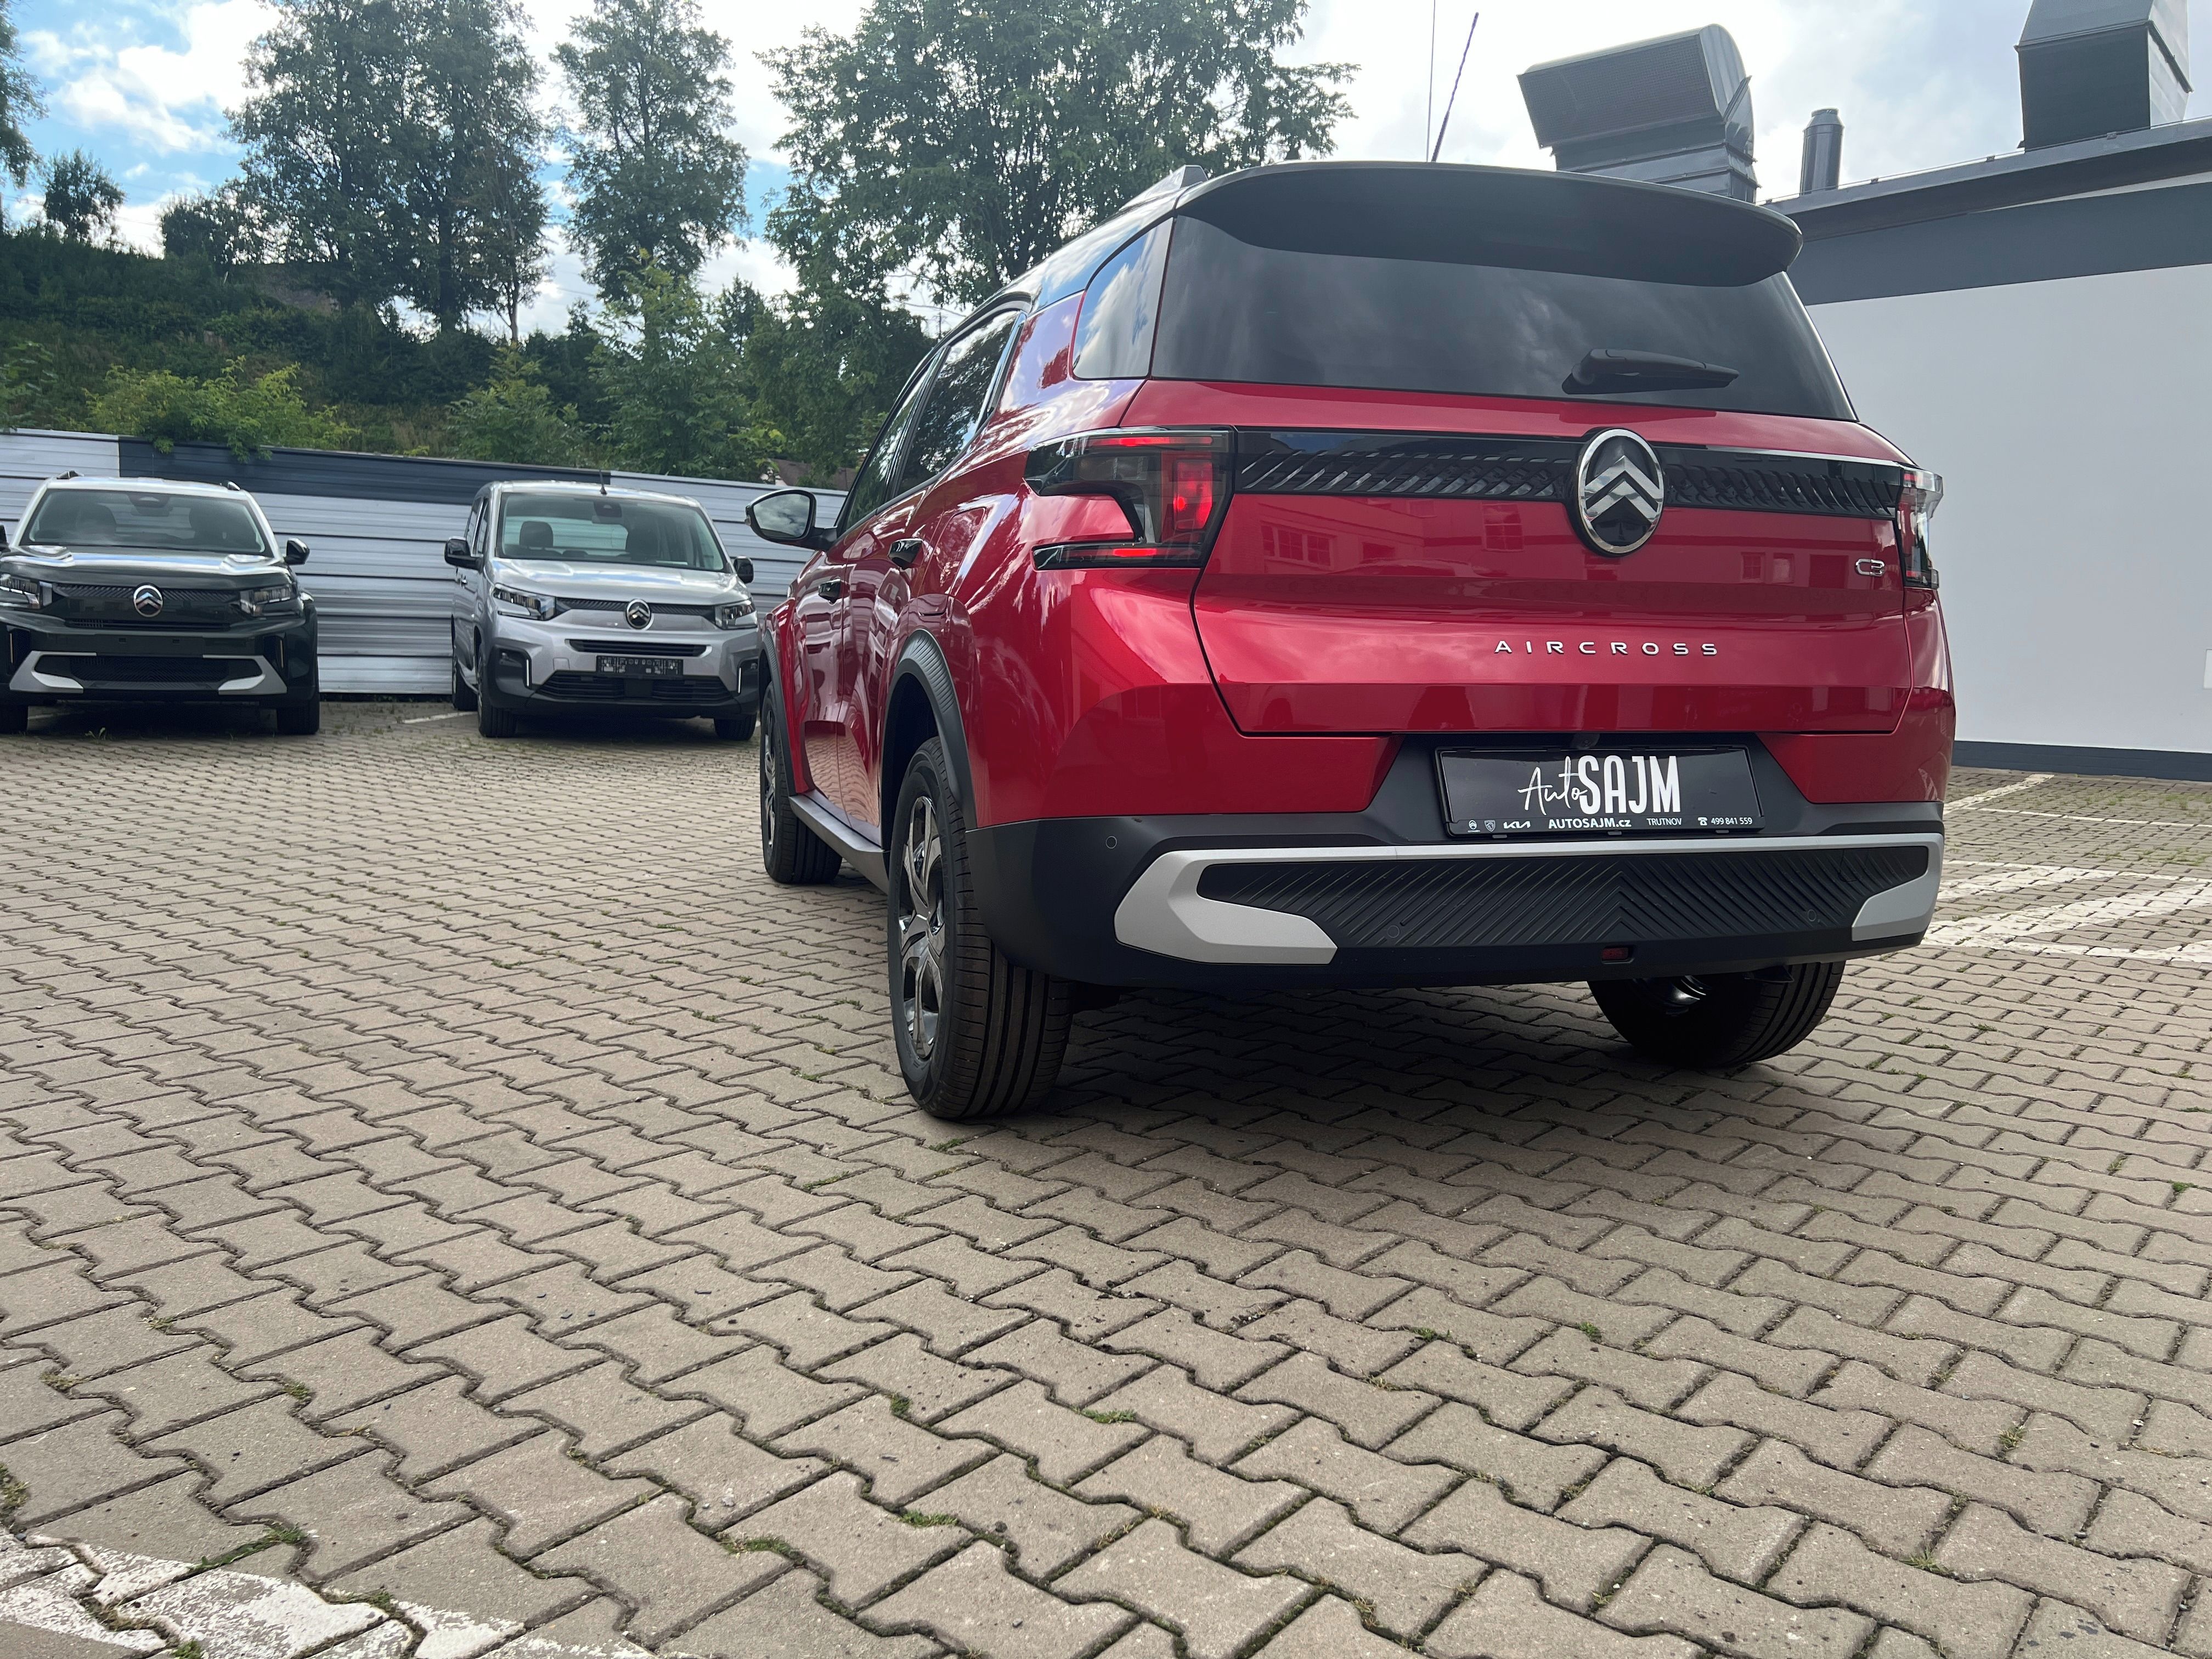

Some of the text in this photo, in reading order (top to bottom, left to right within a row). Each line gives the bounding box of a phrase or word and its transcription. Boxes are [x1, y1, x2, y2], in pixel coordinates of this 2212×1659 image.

[1855, 558, 1885, 577] C3
[1494, 640, 1718, 656] AIRCROSS
[1548, 817, 1632, 829] AUTOSAJM.cz
[1646, 817, 1682, 826] TRUTNOV
